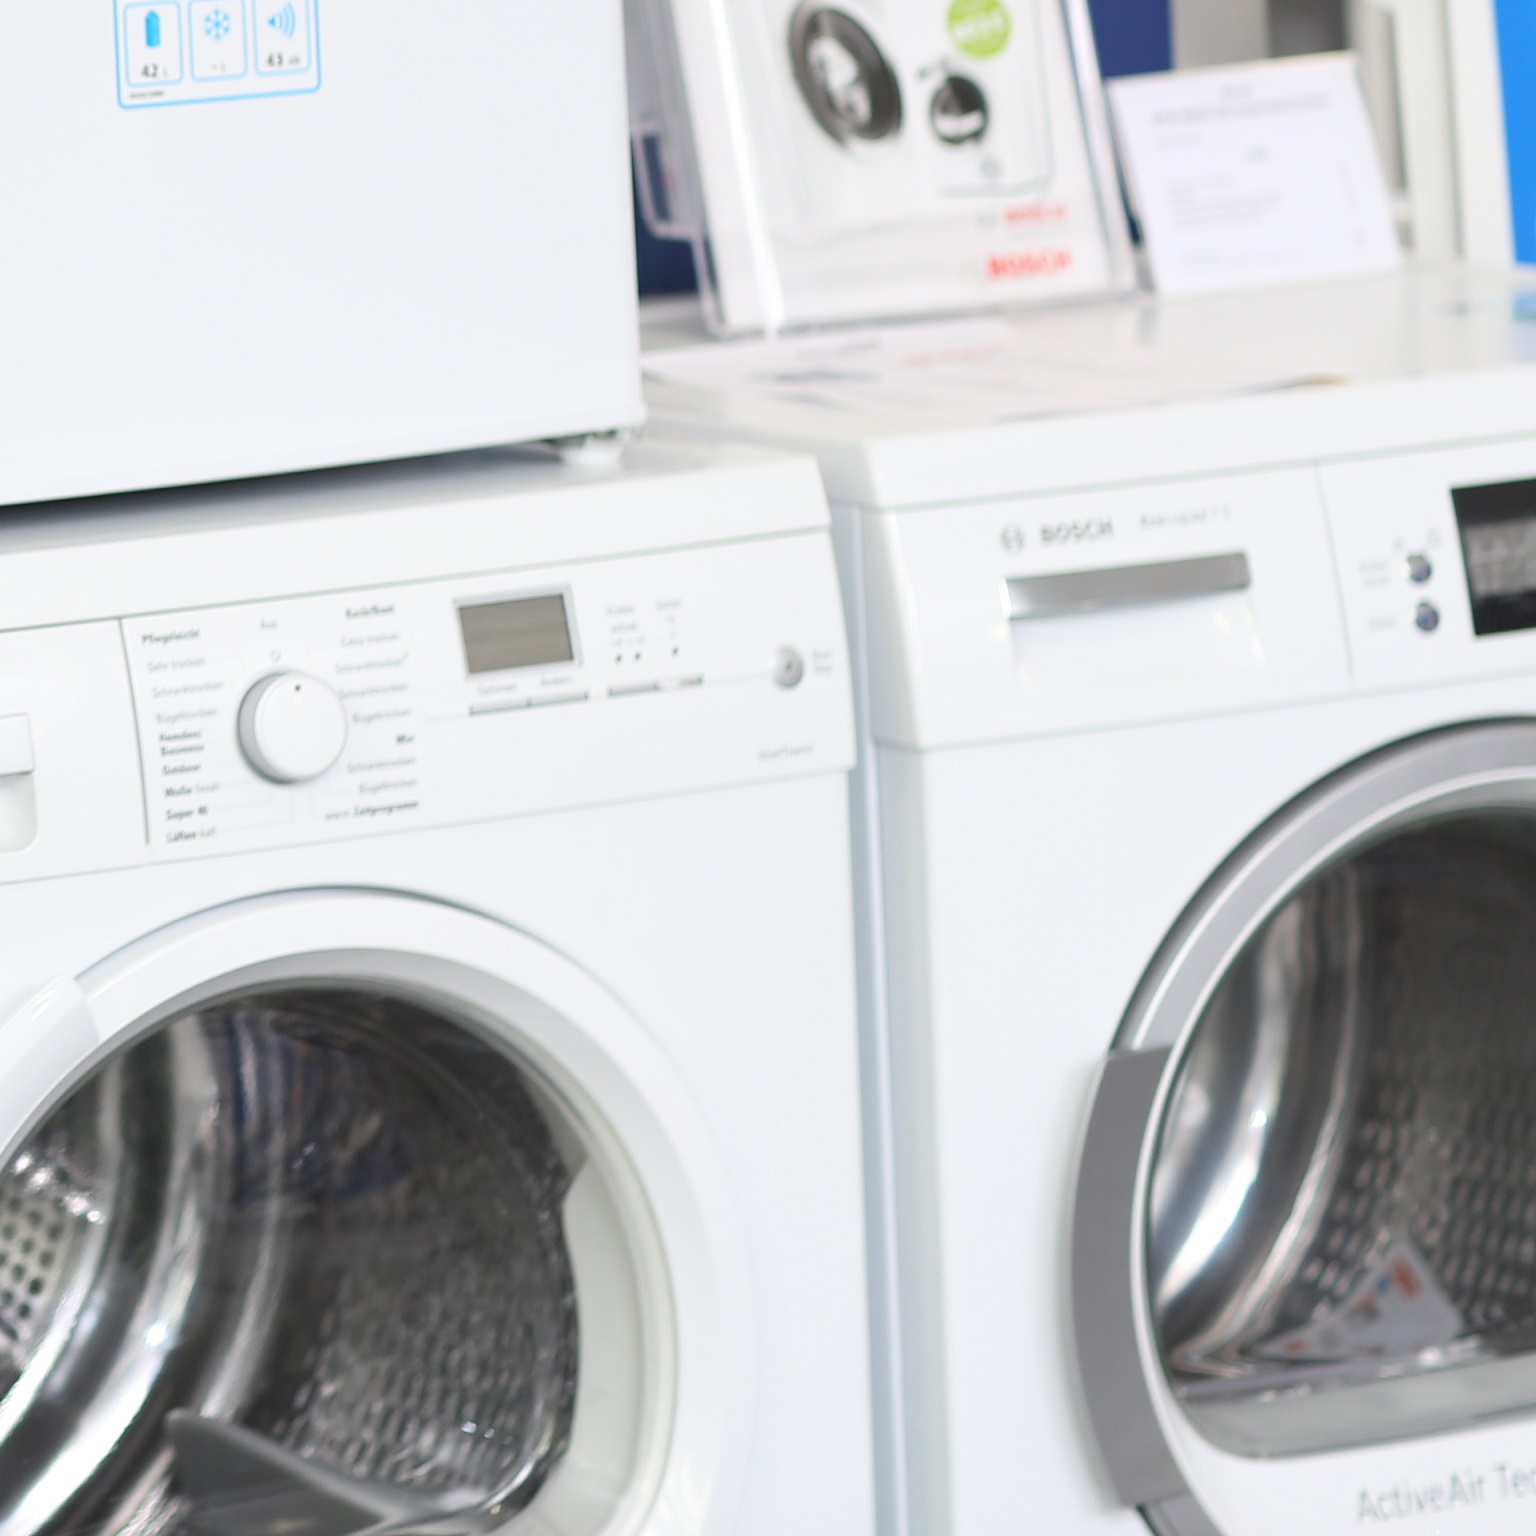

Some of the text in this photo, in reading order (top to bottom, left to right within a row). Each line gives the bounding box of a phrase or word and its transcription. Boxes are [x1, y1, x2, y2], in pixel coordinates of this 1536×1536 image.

[140, 63, 159, 79] 42
[265, 51, 284, 68] 43
[986, 246, 1071, 281] BOSCH
[1038, 515, 1113, 547] BOSCH
[1354, 1468, 1487, 1527] ActiveAir
